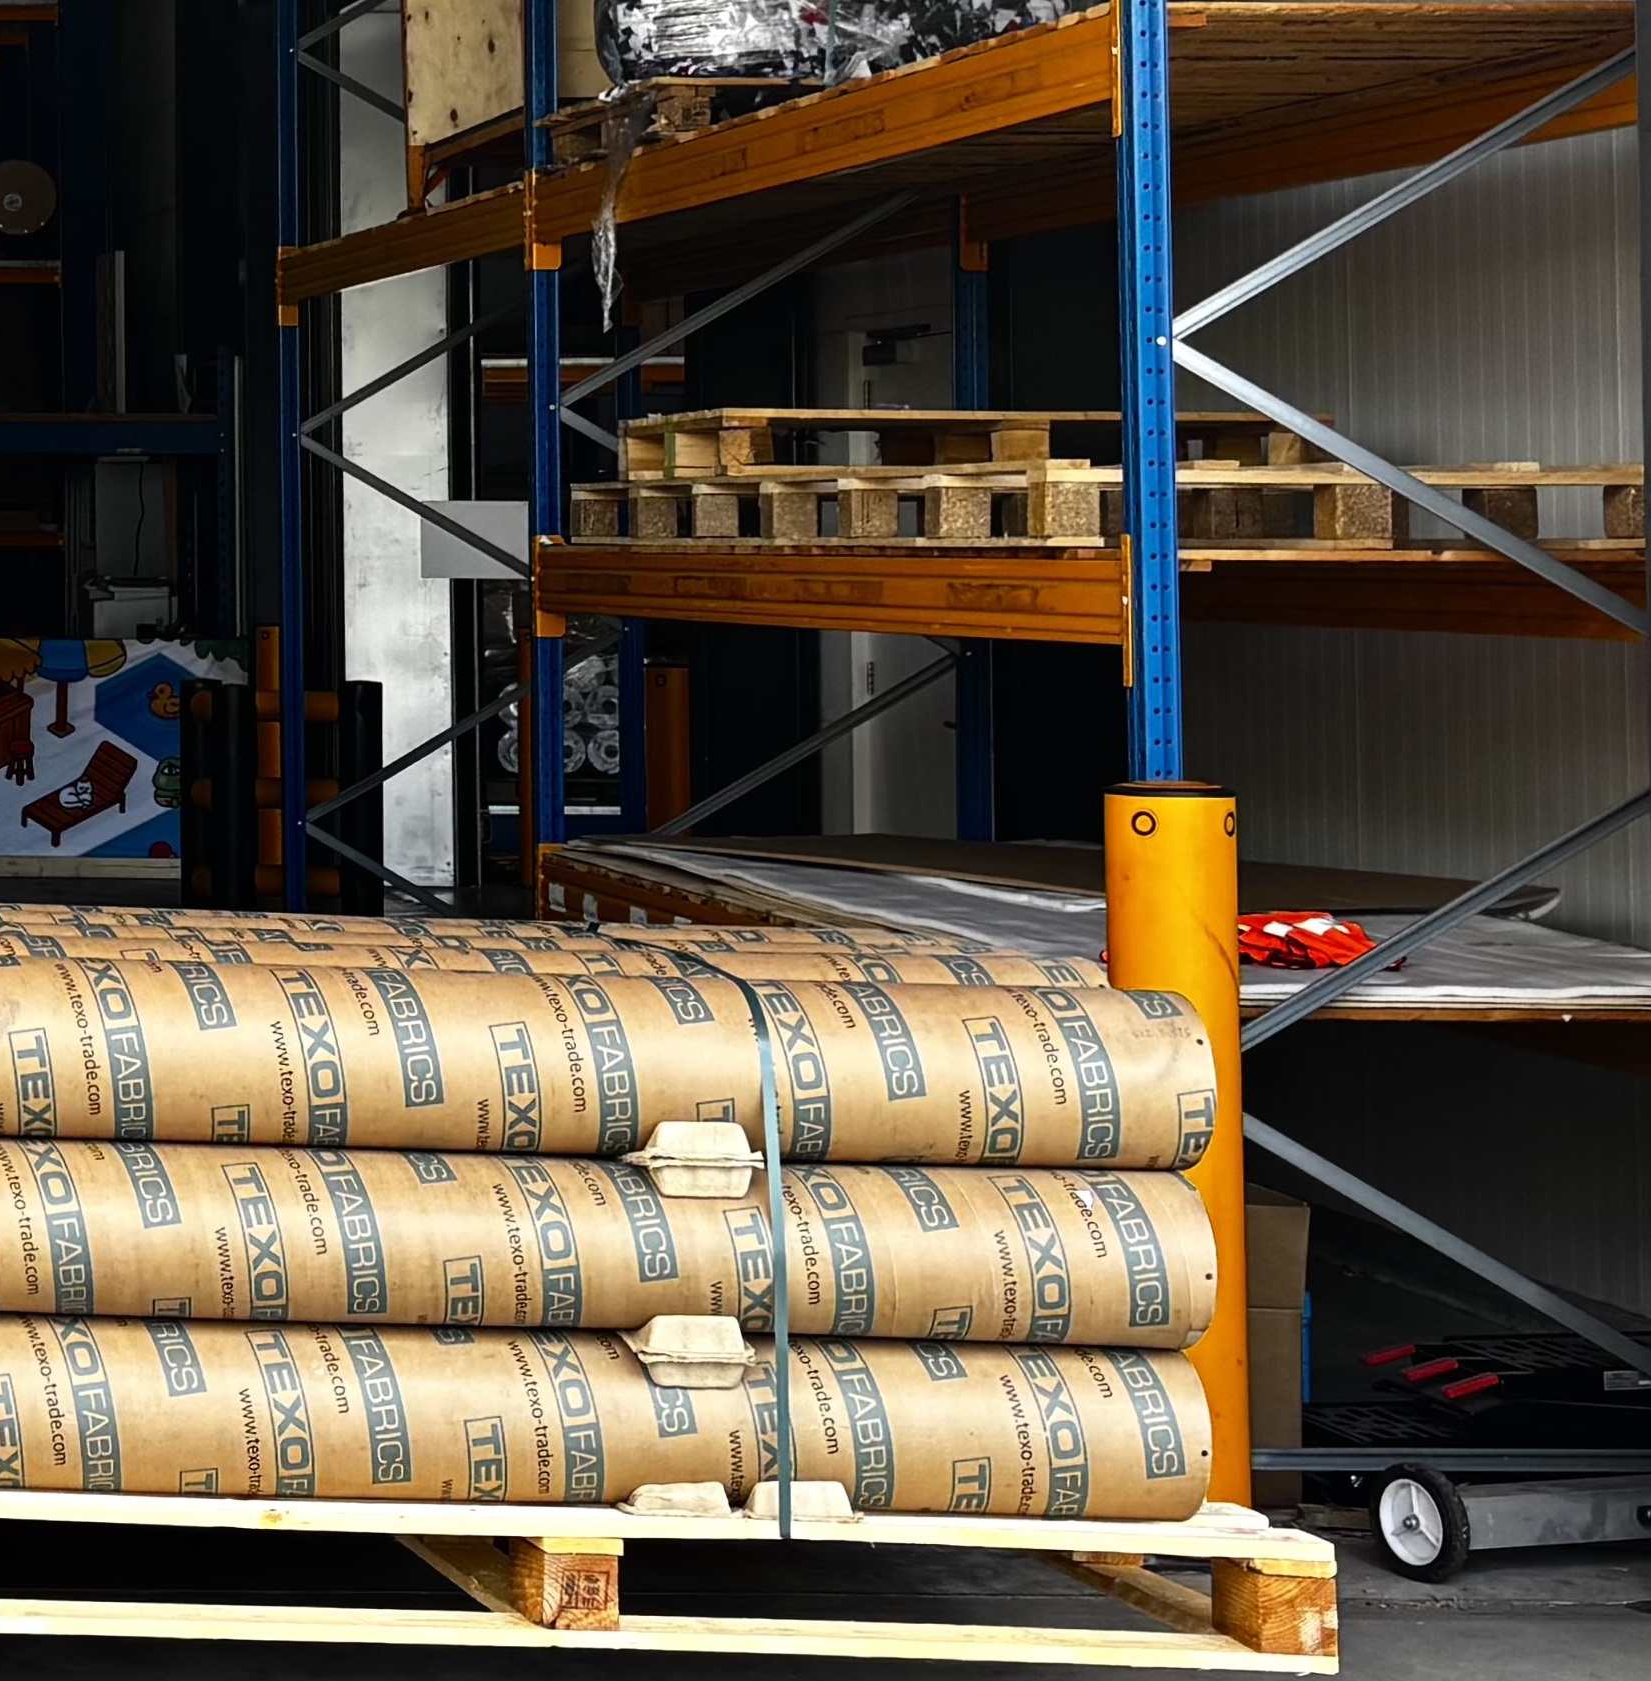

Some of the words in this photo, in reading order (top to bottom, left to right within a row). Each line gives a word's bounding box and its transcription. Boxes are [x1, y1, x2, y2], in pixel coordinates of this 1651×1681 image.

[87, 964, 134, 1019] XO
[280, 971, 342, 1099] TEXO
[377, 972, 438, 1104] FABRICS
[853, 983, 919, 1097] ABRICS
[500, 1027, 539, 1151] TEXO
[975, 1020, 1022, 1156] TEXO
[1061, 1019, 1118, 1160] FABRICS
[25, 1144, 76, 1209] XO
[231, 1166, 286, 1306] TEXO
[521, 1163, 574, 1260] EXO
[615, 1164, 671, 1281] ABRICS
[332, 1173, 382, 1315] FABRICS
[731, 1213, 774, 1330] TEXO
[1000, 1177, 1067, 1311] TEXO
[1104, 1173, 1166, 1328] FABRICS
[59, 1322, 101, 1377] XO
[154, 1322, 199, 1394] RICS
[253, 1332, 312, 1475] TEXO
[347, 1331, 408, 1484] FABRICS
[1023, 1354, 1085, 1460] EXO
[471, 1422, 505, 1502] TEX
[846, 1372, 891, 1509] FABRICS
[1114, 1350, 1181, 1475] ABRICS
